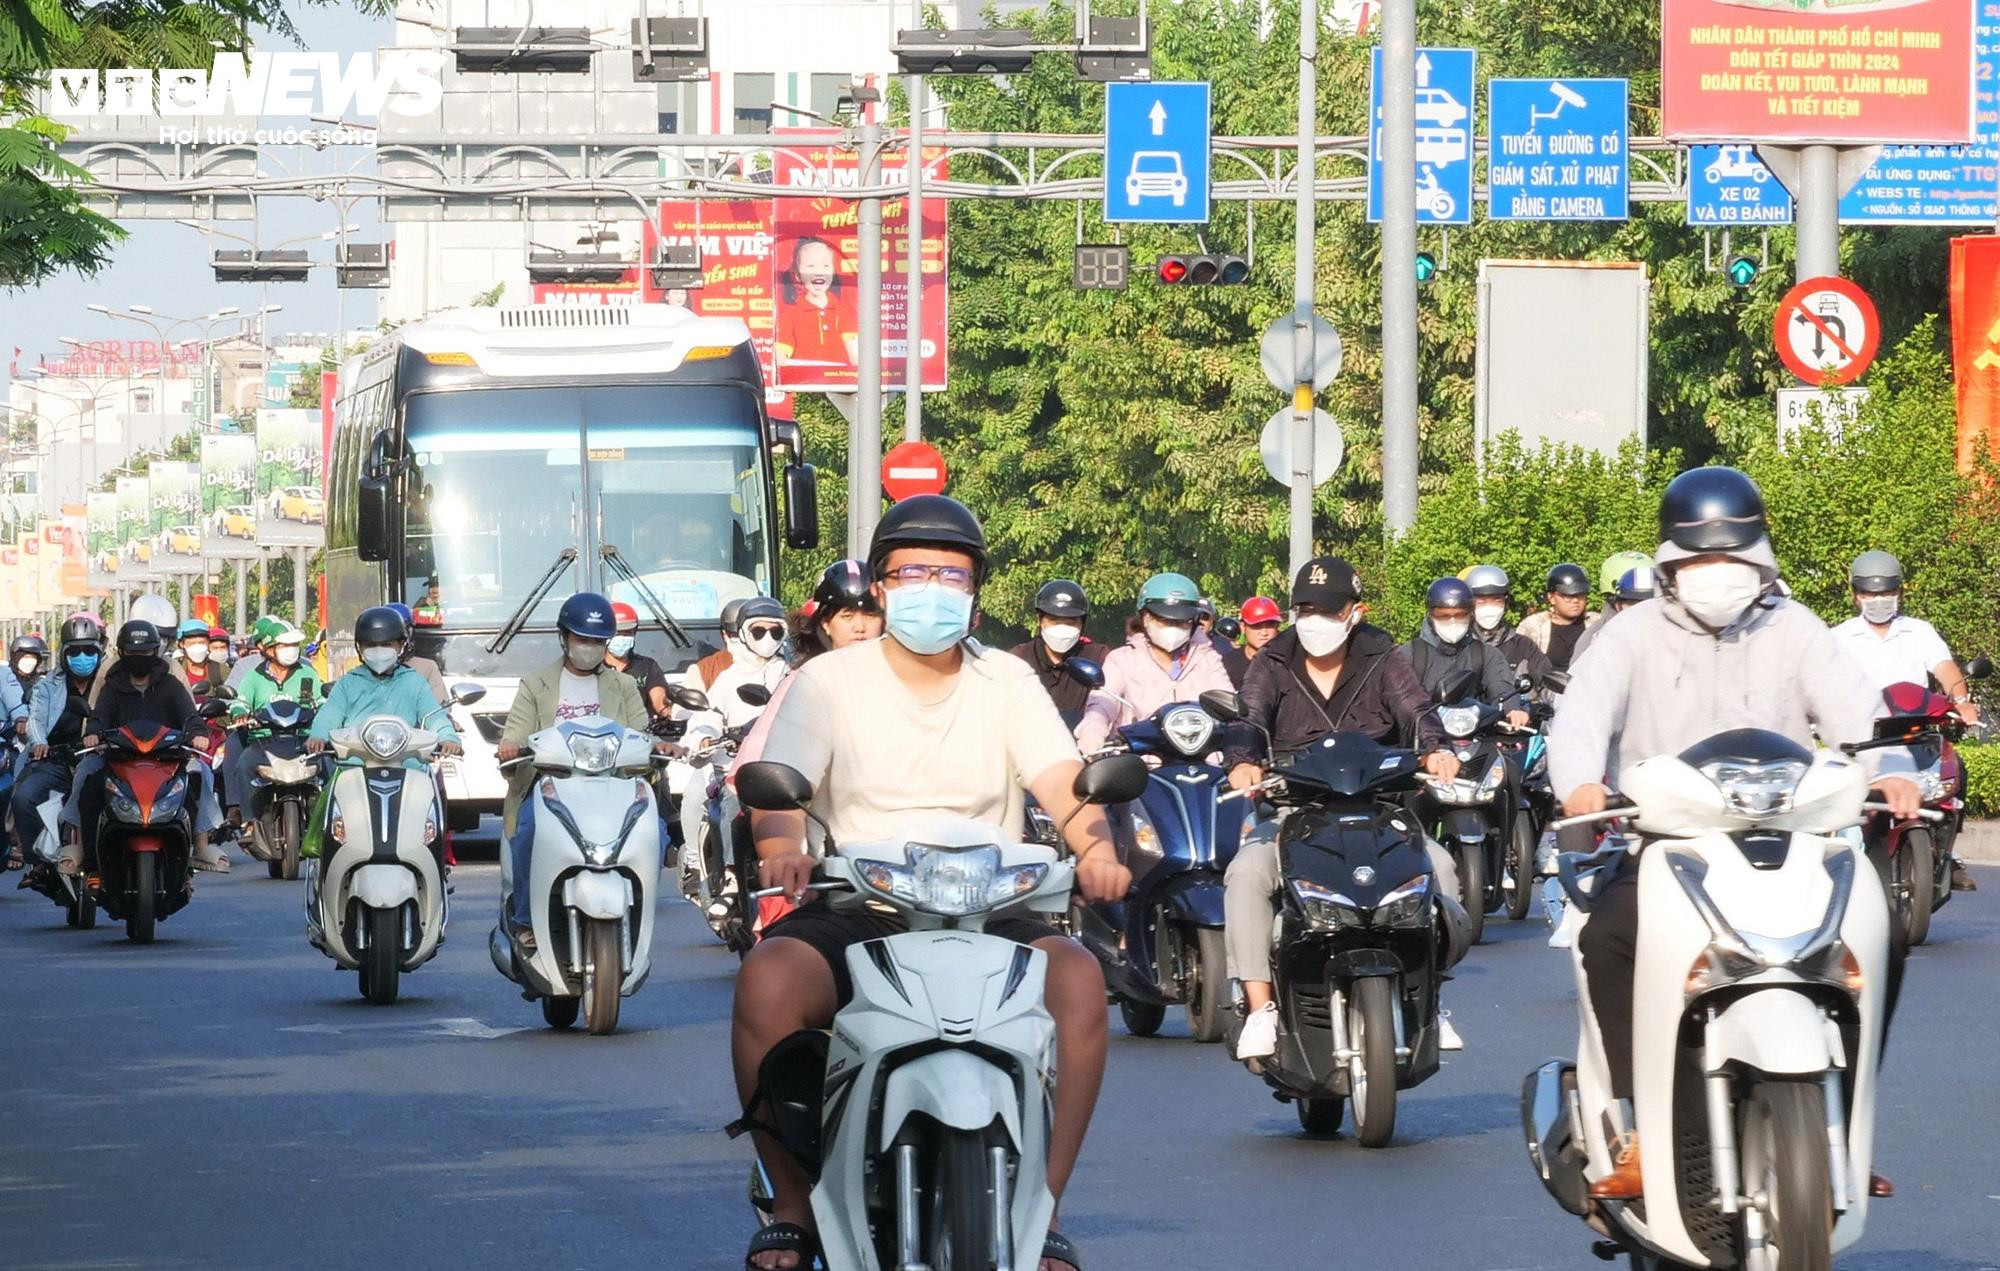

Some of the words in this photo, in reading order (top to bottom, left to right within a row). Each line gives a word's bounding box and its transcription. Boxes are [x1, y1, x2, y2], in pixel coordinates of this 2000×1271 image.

[1690, 25, 1732, 45] NHÂN
[1734, 25, 1764, 45] DÂN
[1768, 26, 1815, 46] THÀNH
[1818, 25, 1848, 47] PHỐ
[1851, 25, 1871, 48] HỒ
[1874, 26, 1899, 48] CHÍ
[1902, 31, 1941, 49] MINH
[1730, 49, 1761, 68] ĐÓN
[1763, 47, 1788, 69] TẾT
[1791, 49, 1825, 70] GIÁP
[1829, 50, 1862, 70] THÌN
[1865, 54, 1900, 71] 2024
[1701, 71, 1741, 92] ĐOÀN
[1744, 72, 1773, 93] KẾT,
[1776, 75, 1800, 92] VUI
[1803, 74, 1839, 94] TƯƠI,
[1843, 74, 1881, 94] LÀNH
[1884, 77, 1928, 97] MẠNH
[1768, 95, 1788, 116] VÀ
[1791, 94, 1820, 116] TIẾT
[1823, 97, 1860, 119] KIỆM
[1501, 128, 1542, 154] TUYẾN
[1601, 129, 1619, 154] CÓ
[1492, 161, 1524, 186] GIÁM
[1585, 166, 1620, 189] PHẠT
[1511, 187, 1546, 217] BẰNG
[1551, 197, 1605, 217] CAMERA
[1720, 187, 1740, 200] XE
[1743, 187, 1760, 201] 02
[1695, 202, 1717, 220] VÀ
[1720, 207, 1737, 220] 03
[1741, 202, 1785, 220] BÁNH
[1924, 205, 1945, 215] GIAO
[1949, 203, 1980, 215] THÔNG
[728, 262, 758, 281] SINH
[1309, 564, 1328, 585] LA
